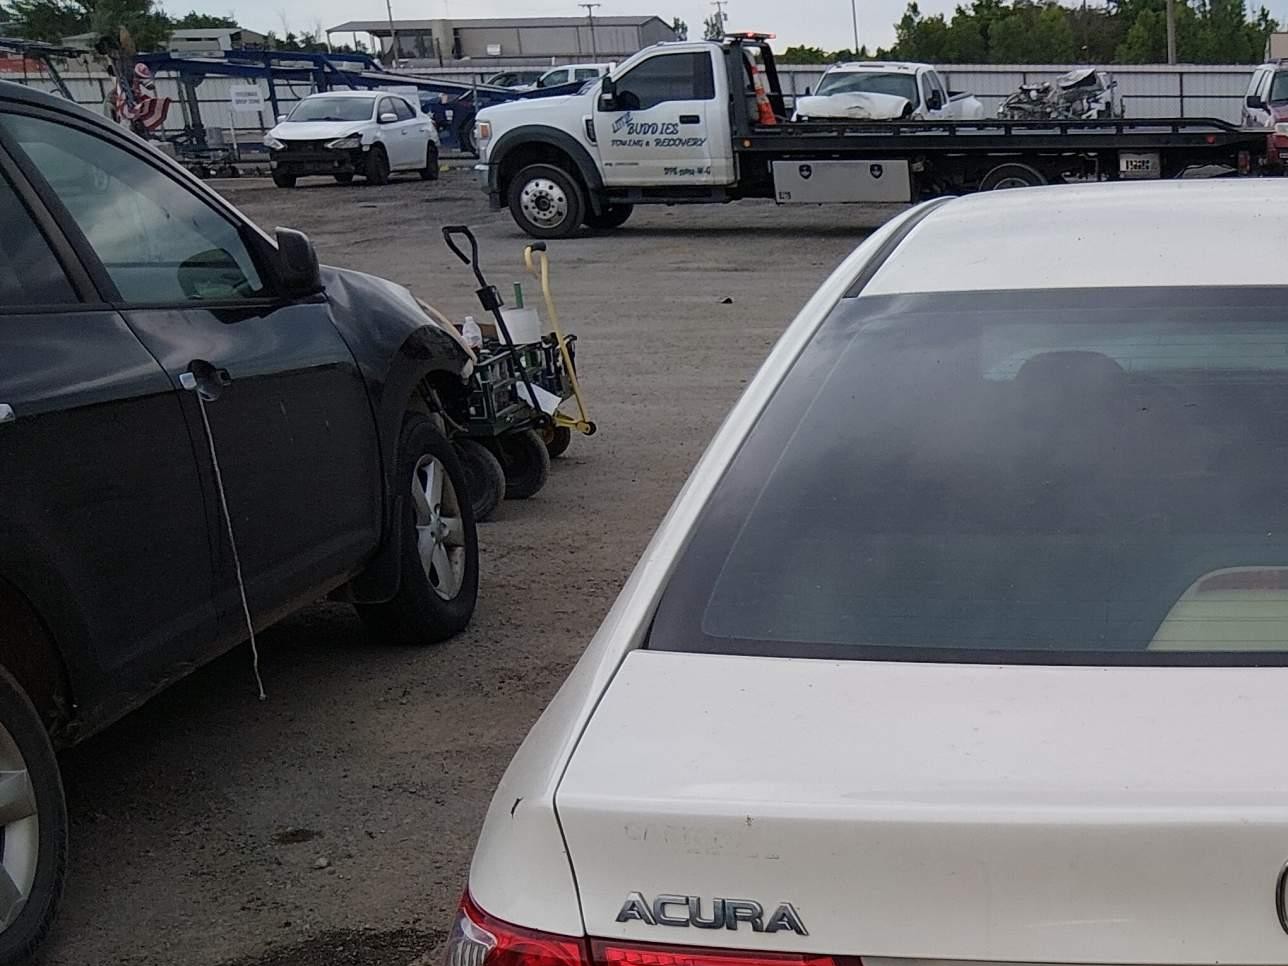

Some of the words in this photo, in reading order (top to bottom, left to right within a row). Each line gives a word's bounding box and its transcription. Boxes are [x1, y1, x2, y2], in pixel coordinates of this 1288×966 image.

[626, 122, 679, 135] BUDDIES
[611, 139, 643, 147] TOWING
[654, 137, 706, 148] RECOVERY
[615, 890, 809, 937] ACURA
